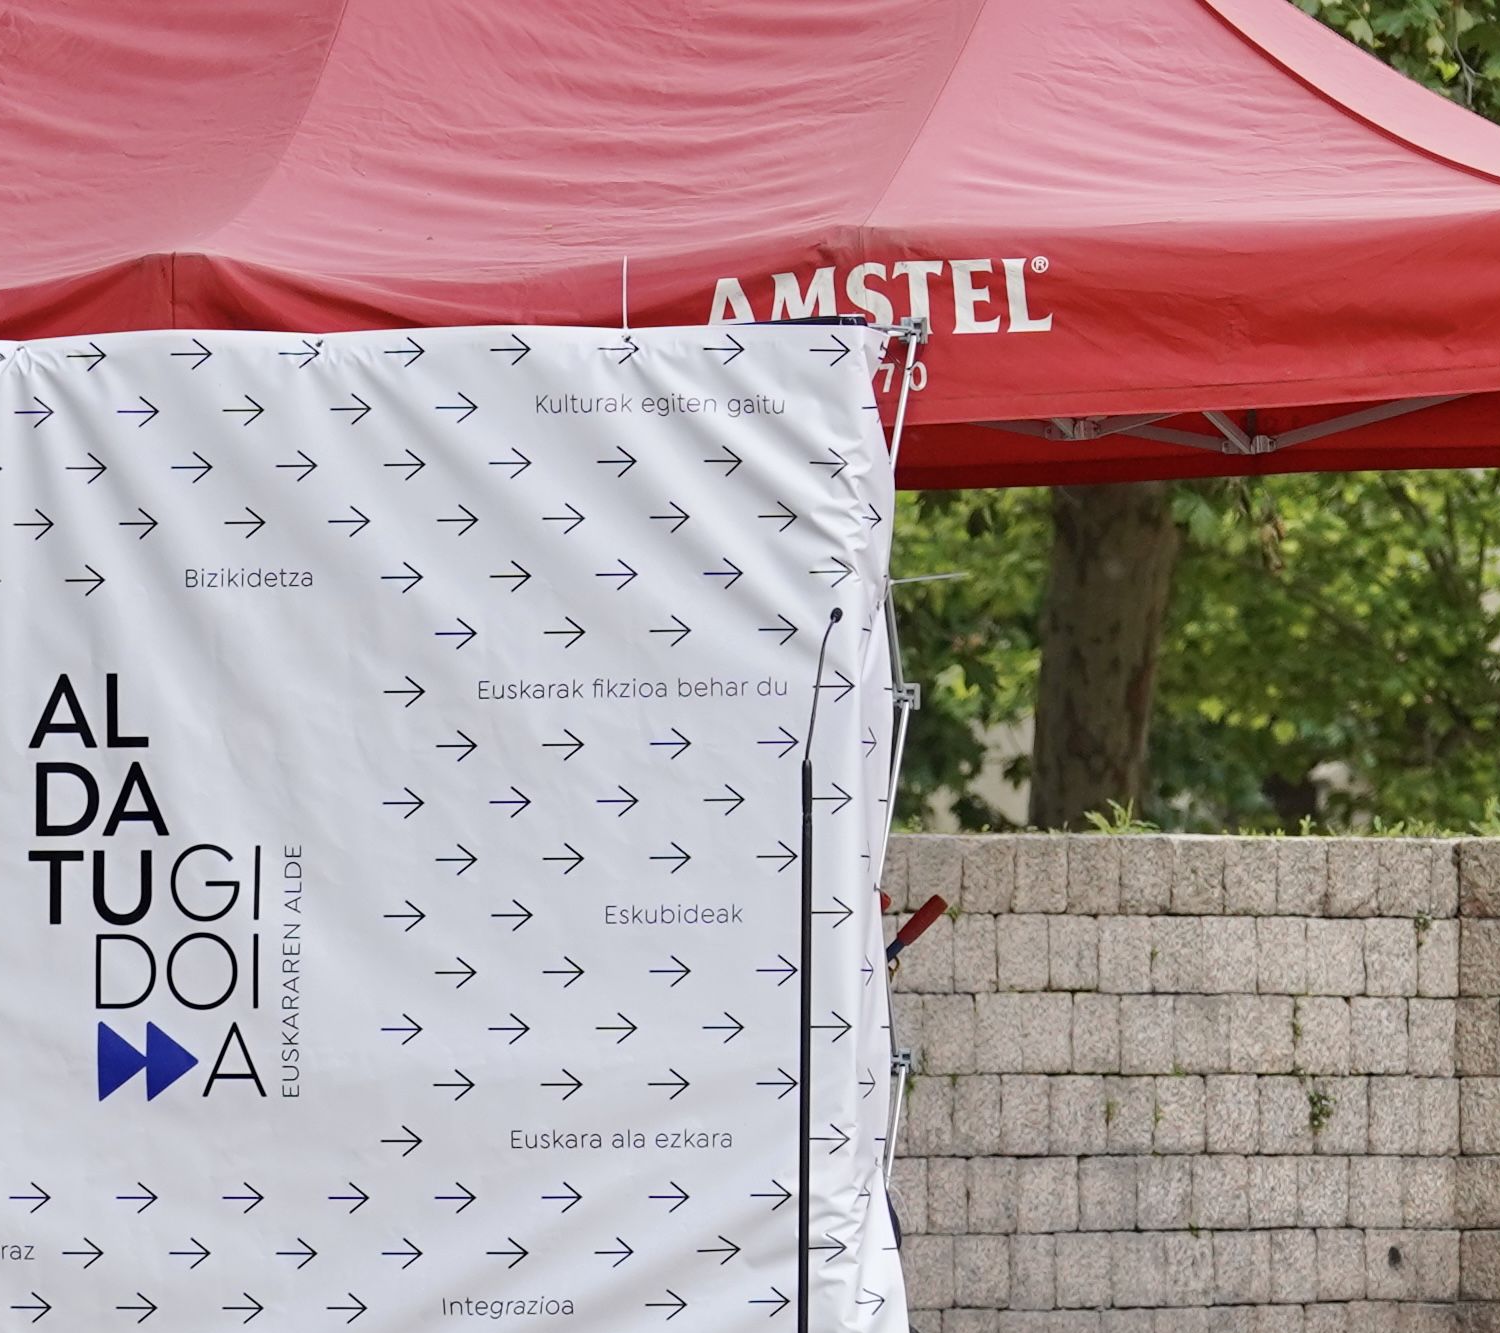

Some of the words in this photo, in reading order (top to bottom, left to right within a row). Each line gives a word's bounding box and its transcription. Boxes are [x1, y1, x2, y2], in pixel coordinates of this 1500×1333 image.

[535, 393, 633, 415] Kulturak
[641, 393, 717, 418] egiten
[727, 393, 786, 418] gaitu
[185, 567, 314, 589] Bizikidetza
[28, 673, 149, 748] AL
[478, 679, 585, 700] Euskarak
[591, 678, 668, 699] fikzioa
[677, 677, 750, 698] behar
[756, 676, 788, 697] du
[35, 761, 170, 837] DA
[283, 845, 303, 914] ALDE
[605, 904, 743, 925] Eskubideak
[95, 932, 259, 1011] DOI
[281, 923, 302, 1098] EUSKARAREN
[202, 1021, 267, 1098] A
[510, 1128, 603, 1150] Euskara
[611, 1128, 646, 1150] ala
[655, 1128, 733, 1149] ezkara
[442, 1296, 575, 1320] Integrazioa
